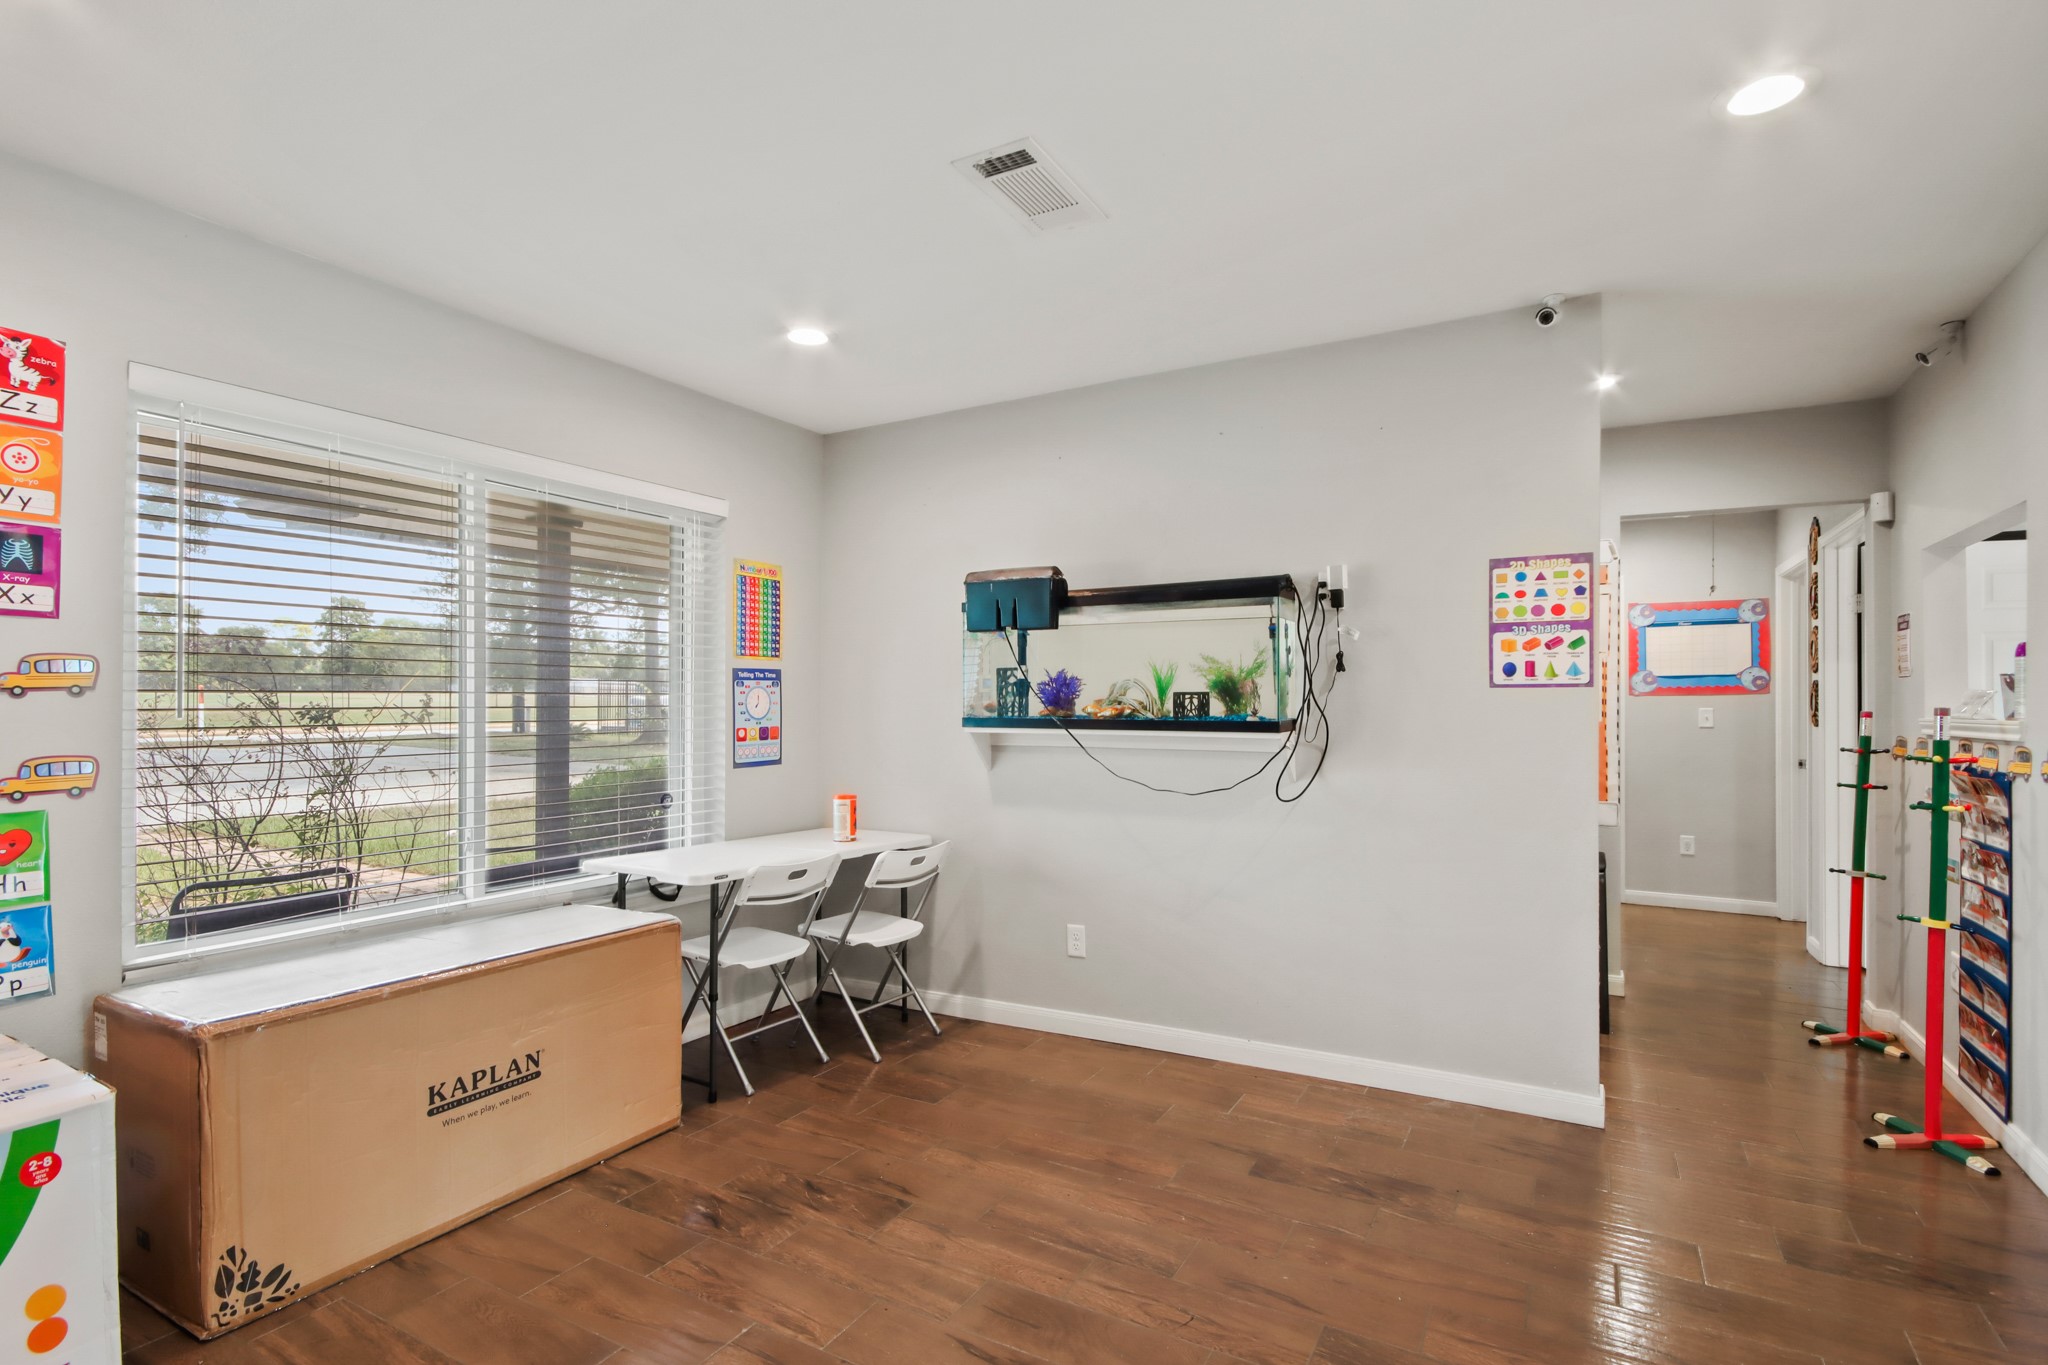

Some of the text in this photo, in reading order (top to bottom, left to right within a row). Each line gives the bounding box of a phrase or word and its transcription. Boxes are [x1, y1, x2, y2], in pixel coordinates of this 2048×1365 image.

[30, 356, 57, 368] zebra
[0, 389, 38, 414] Z z
[13, 476, 39, 486] yo-yo
[1509, 558, 1572, 571] 2D Shapes
[3, 573, 31, 584] X-ray
[1511, 623, 1572, 636] 3D Shapes
[738, 671, 754, 679] Telling
[16, 859, 43, 868] heart
[11, 957, 48, 971] penguin
[428, 1050, 541, 1106] KAPLAN
[433, 1073, 537, 1114] EARLY LEARNING COMPANY
[441, 1090, 532, 1128] When we play, we learn.
[29, 1156, 53, 1172] 2-8
[32, 1167, 50, 1178] years
